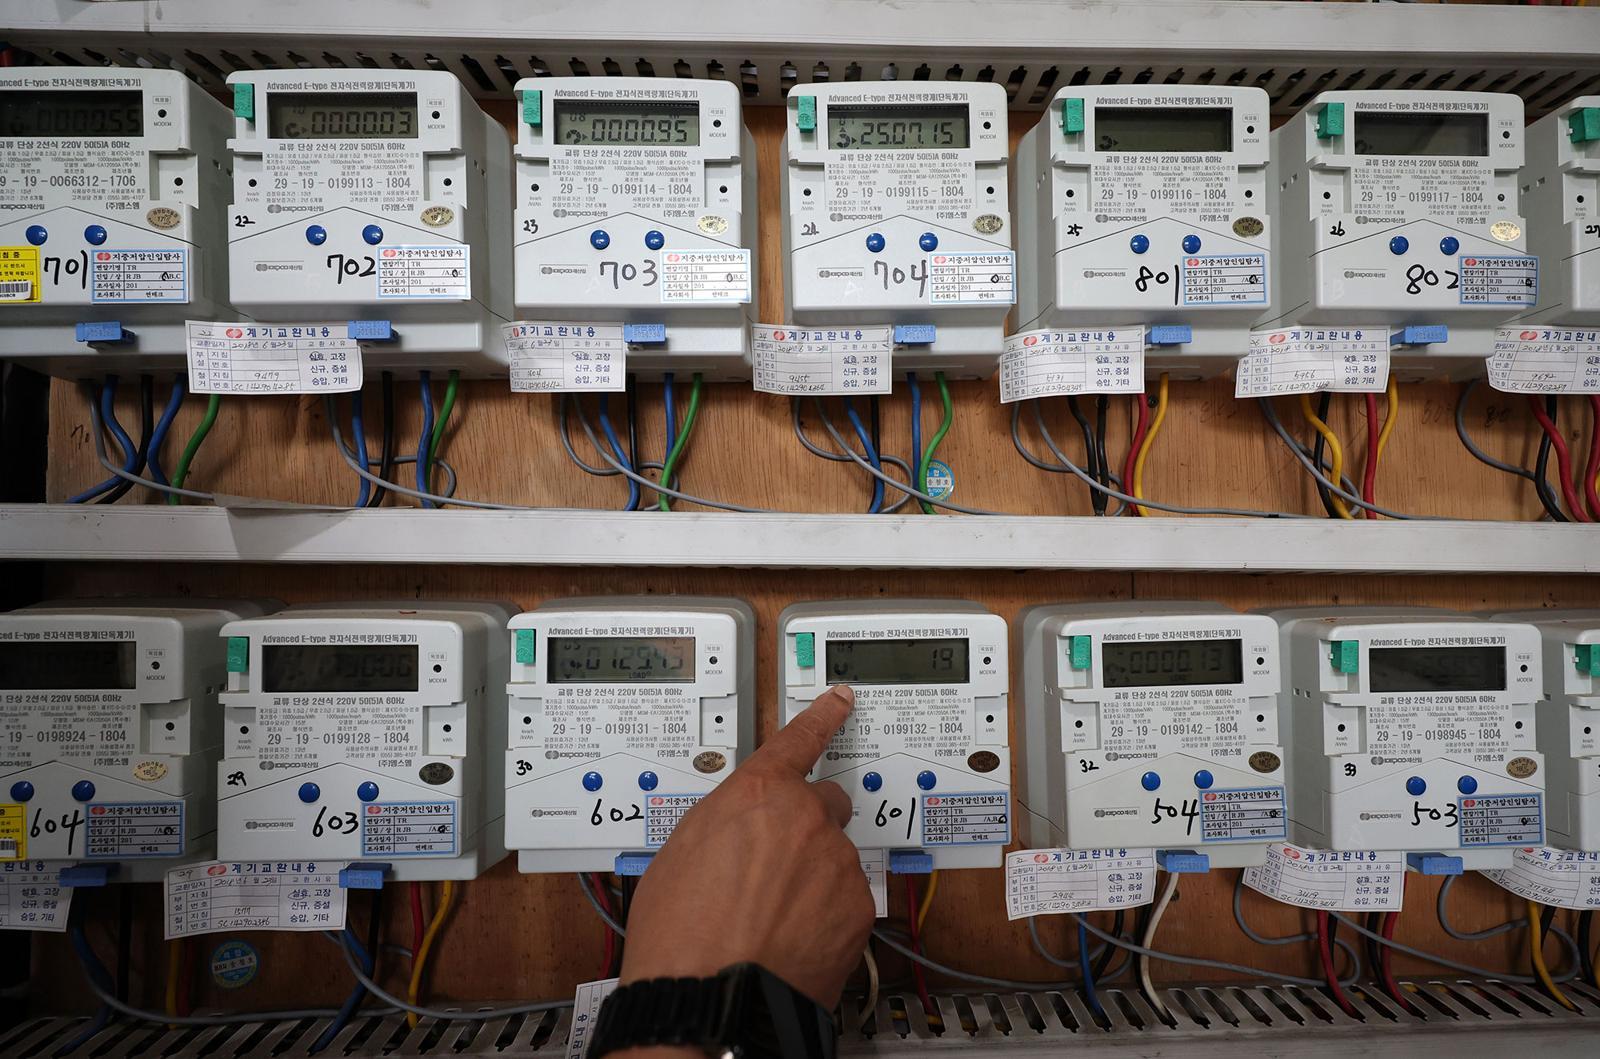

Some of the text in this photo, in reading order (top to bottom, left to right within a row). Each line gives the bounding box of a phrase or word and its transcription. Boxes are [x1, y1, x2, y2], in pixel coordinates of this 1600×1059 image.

[25, 79, 49, 87] E-type
[267, 82, 302, 90] Advanced
[303, 82, 327, 90] E-type
[590, 90, 613, 98] E-type
[1096, 97, 1128, 105] Advanced
[1130, 97, 1151, 106] E-type
[316, 143, 336, 151] 2선식
[340, 143, 358, 151] 220V
[25, 175, 135, 186] 19 0066312 1706
[275, 177, 411, 189] 29 19 0199113 1804
[561, 183, 692, 194] 29 19 0199114 1804
[837, 186, 964, 198] 29 19 0199115 1804
[1102, 189, 1226, 199] 29 19 0199116 1804
[1362, 191, 1483, 202] 29 19 0199117 1804
[523, 219, 538, 233] 23
[43, 250, 88, 289] 701
[327, 254, 376, 284] 702
[600, 259, 658, 289] 703
[874, 260, 928, 297] 704
[1406, 264, 1459, 295] 802
[1135, 265, 1179, 305] 801
[15, 632, 40, 640] E-type
[548, 627, 583, 635] Advanced
[585, 627, 608, 635] E-type
[827, 630, 860, 638] Advanced
[862, 630, 885, 638] E-type
[1103, 632, 1136, 640] Advanced
[1138, 632, 1159, 640] E-type
[263, 635, 299, 643] Advanced
[302, 635, 326, 643] E-type
[293, 698, 309, 706] 단상
[337, 697, 356, 705] 220V
[553, 723, 686, 734] 29 19 0199131 1804
[858, 723, 963, 735] 19 0199132 1804
[1112, 722, 1238, 737] 29 19 0199142 1804
[10, 730, 126, 742] 19 0198924 1804
[268, 732, 409, 745] 29 19 0199128 1804
[1377, 729, 1501, 741] 29 19 0198945 1804
[516, 760, 532, 775] 30
[1080, 759, 1099, 772] 32
[591, 799, 644, 825] 602
[875, 797, 915, 839] 601
[1152, 798, 1199, 835] 504
[1411, 801, 1458, 827] 503
[313, 806, 358, 837] 603
[30, 808, 85, 855] 604
